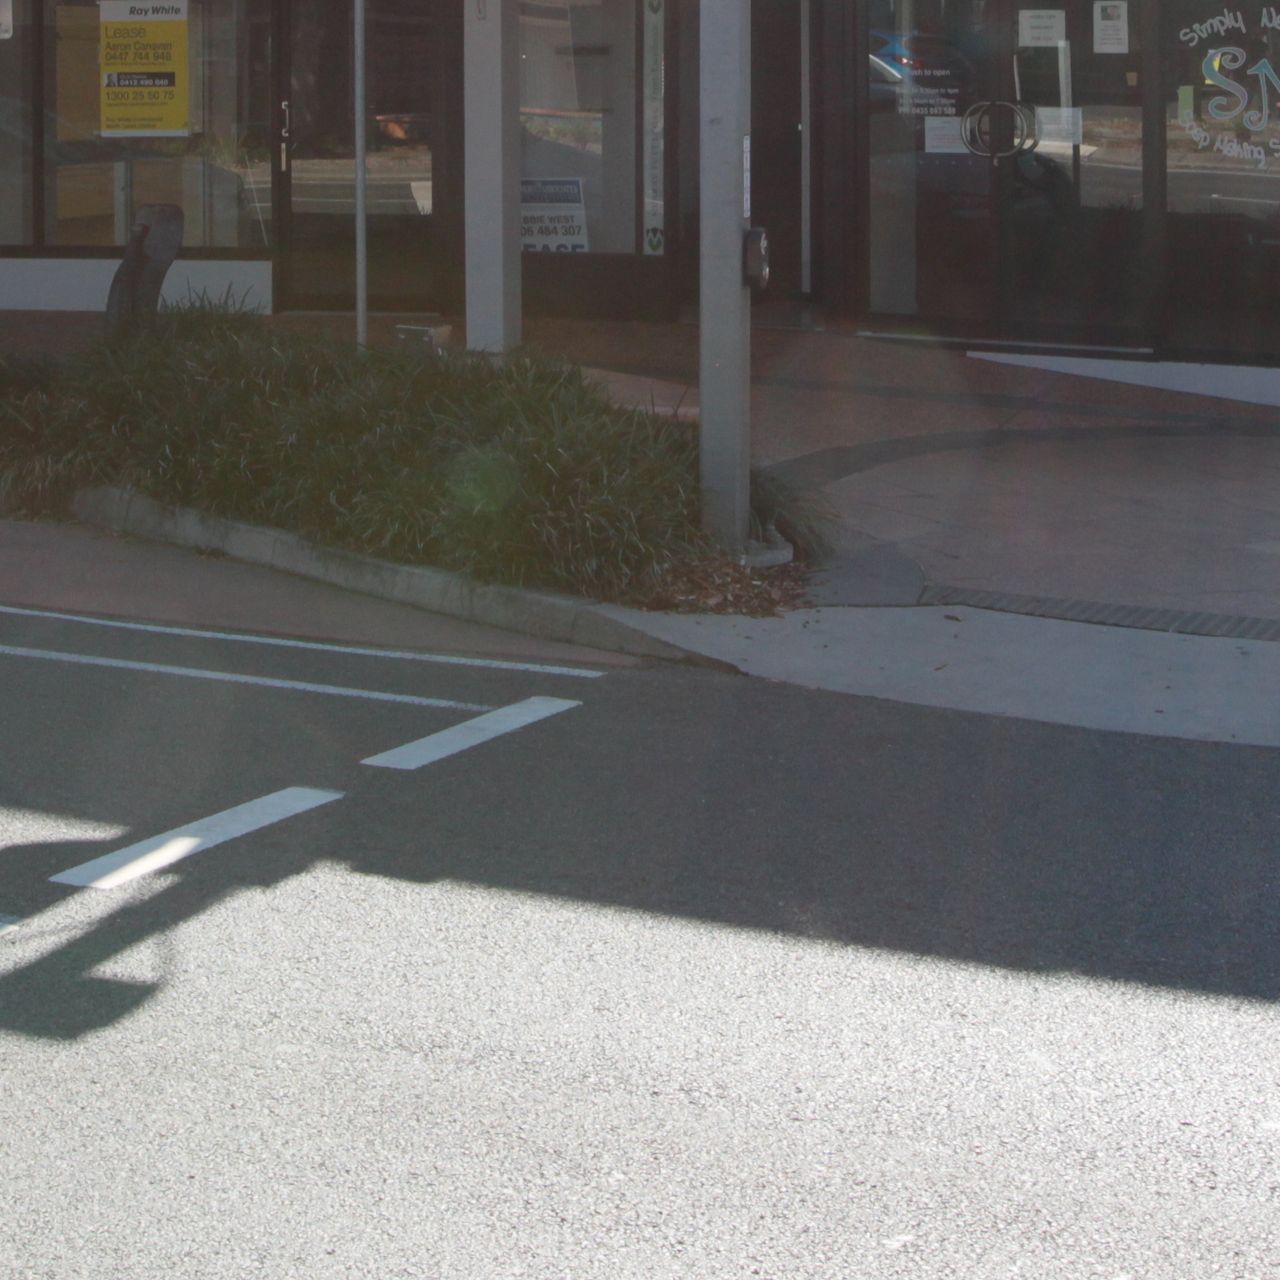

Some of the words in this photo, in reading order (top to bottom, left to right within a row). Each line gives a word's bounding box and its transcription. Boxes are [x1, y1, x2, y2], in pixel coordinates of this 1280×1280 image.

[129, 6, 150, 17] Ray
[151, 5, 181, 16] White
[105, 25, 146, 39] Lease
[1179, 8, 1247, 47] Simply
